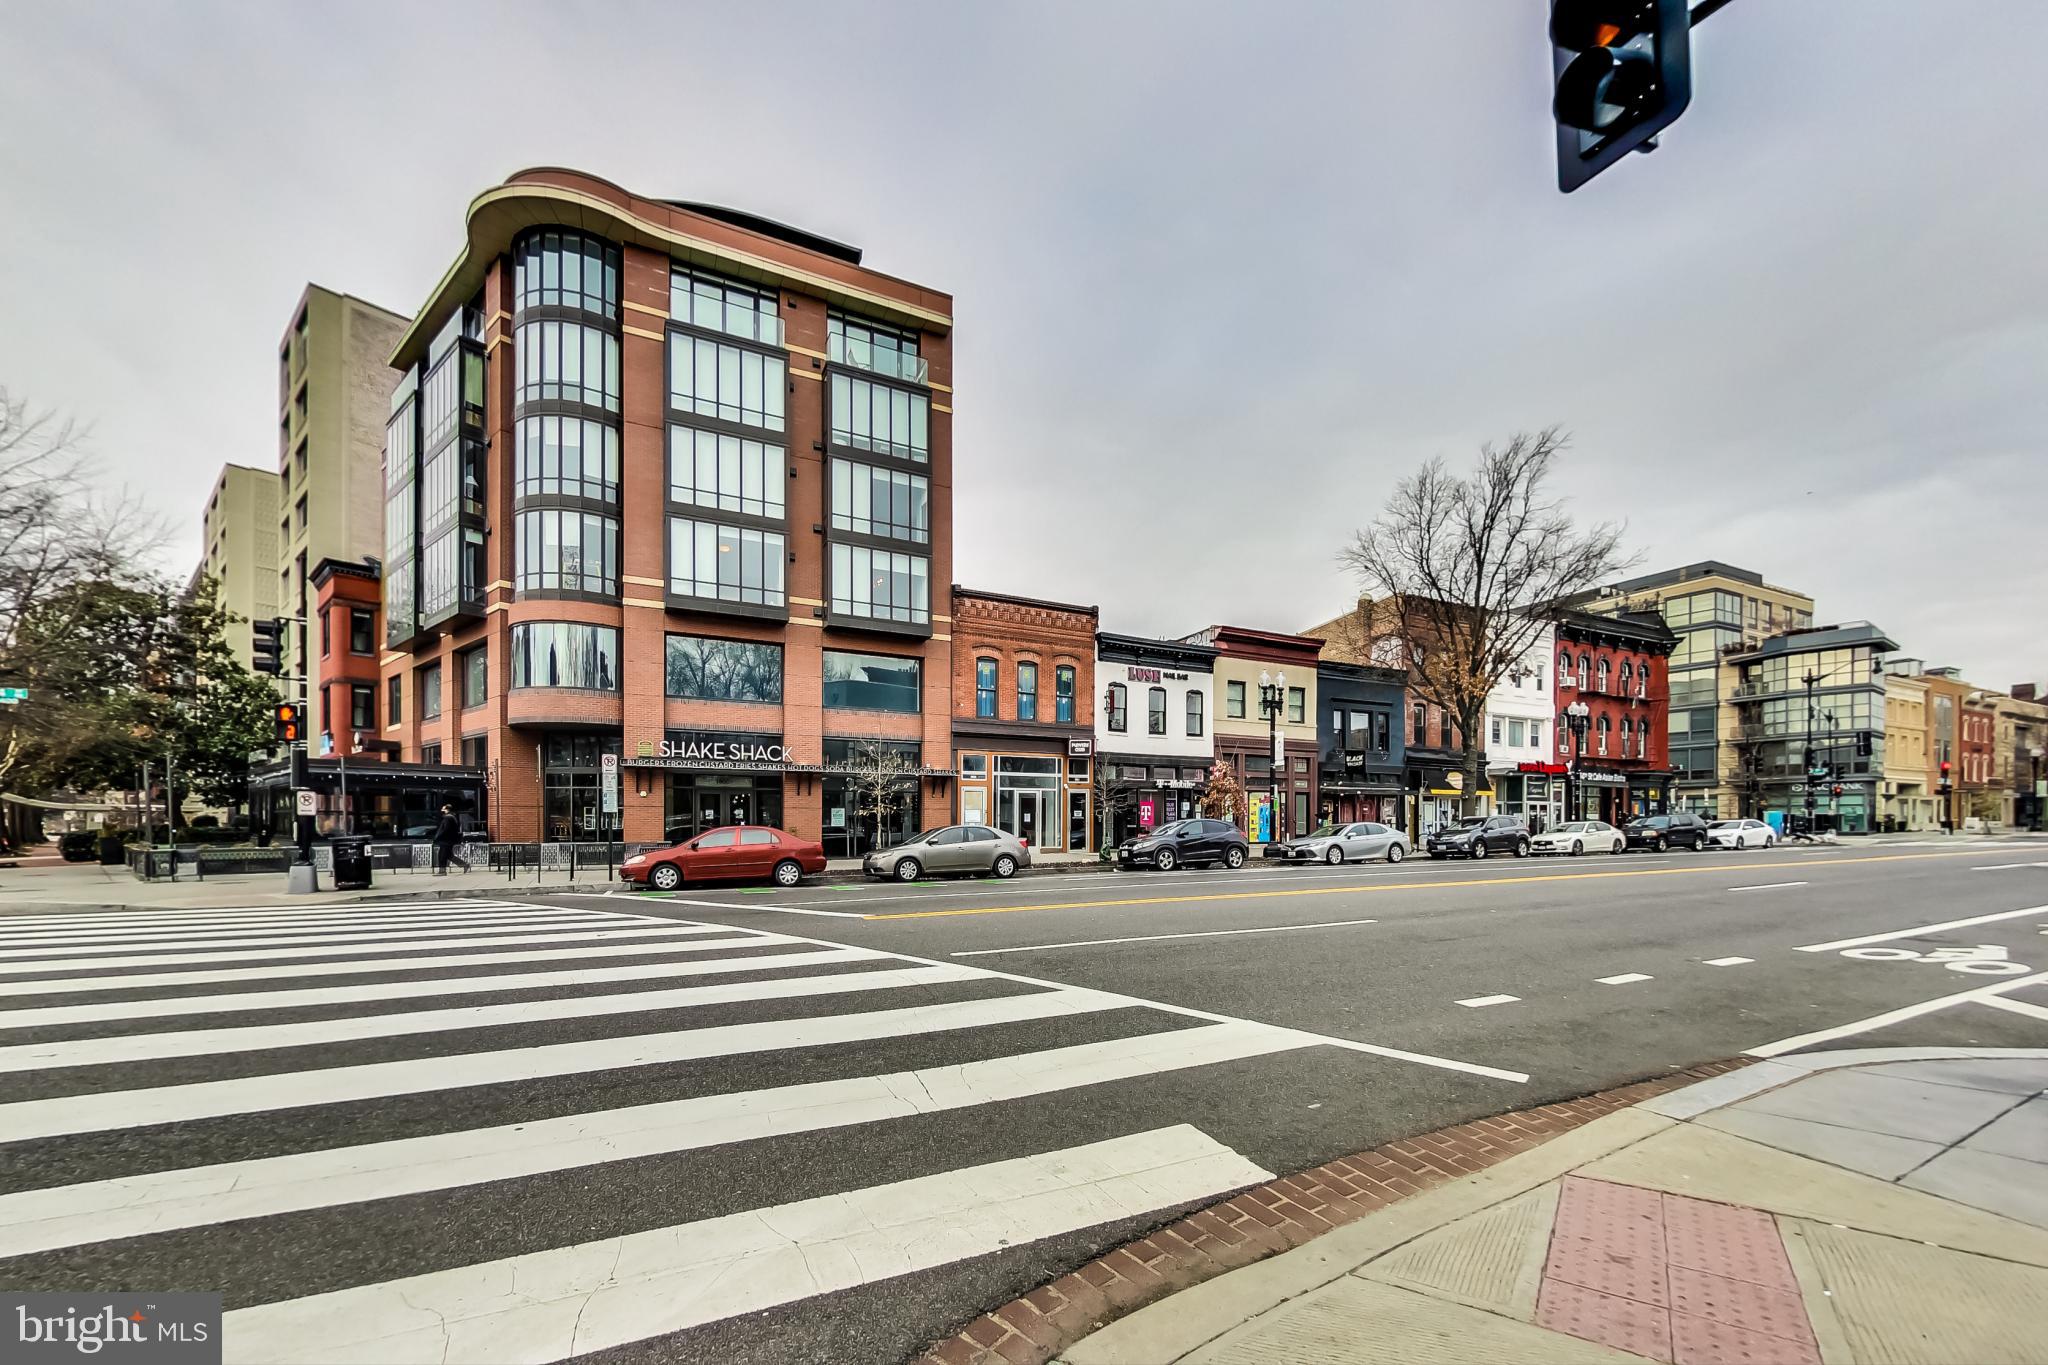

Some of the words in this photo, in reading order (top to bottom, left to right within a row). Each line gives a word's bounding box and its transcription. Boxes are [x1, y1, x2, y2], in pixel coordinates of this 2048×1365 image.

[659, 741, 726, 760] SHAKE
[729, 743, 794, 762] SHACK
[628, 759, 665, 767] BURGERS
[667, 760, 698, 768] FROZEN
[700, 761, 734, 769] CUSTARD
[1141, 806, 1151, 820] T
